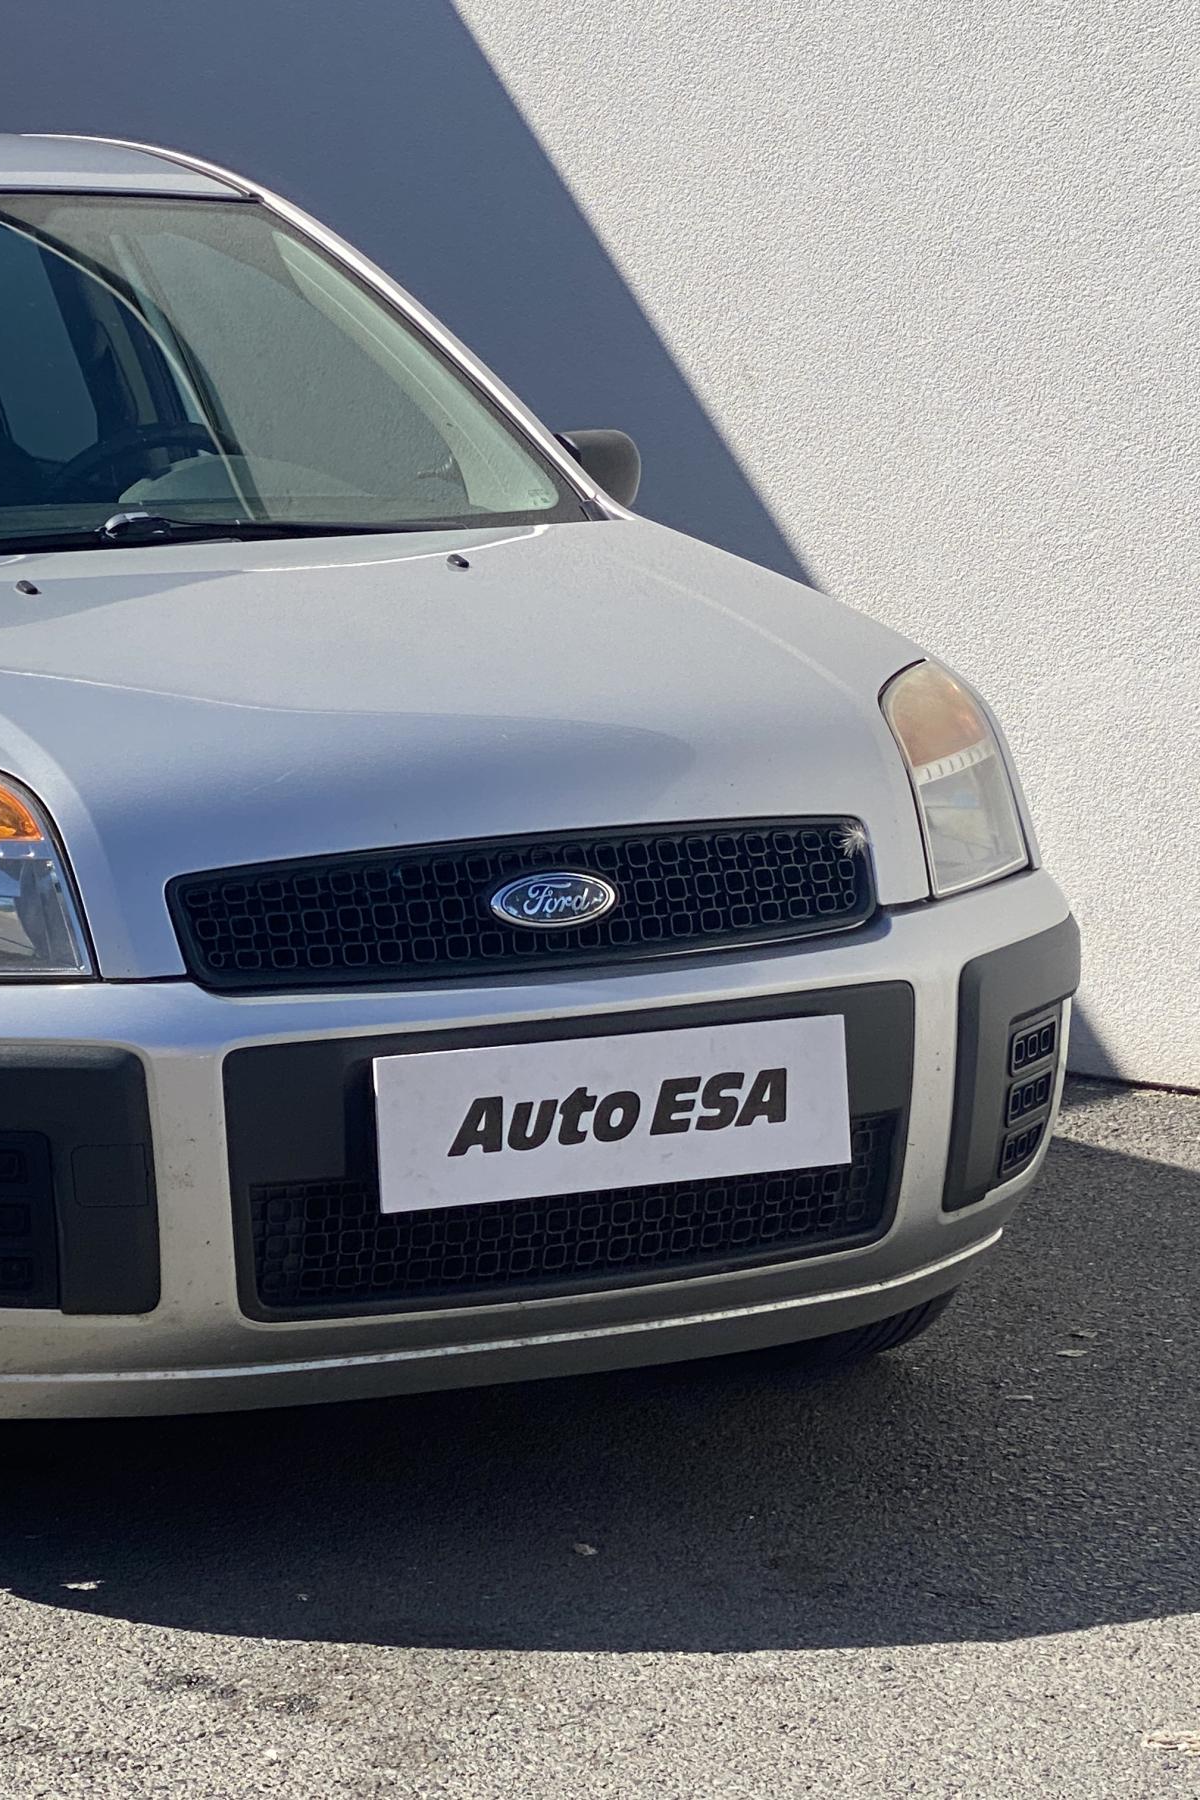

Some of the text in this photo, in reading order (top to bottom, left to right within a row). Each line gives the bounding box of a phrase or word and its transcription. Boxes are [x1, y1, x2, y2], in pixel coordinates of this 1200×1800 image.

[523, 882, 590, 915] Ford
[447, 1067, 788, 1157] Auto ESA
